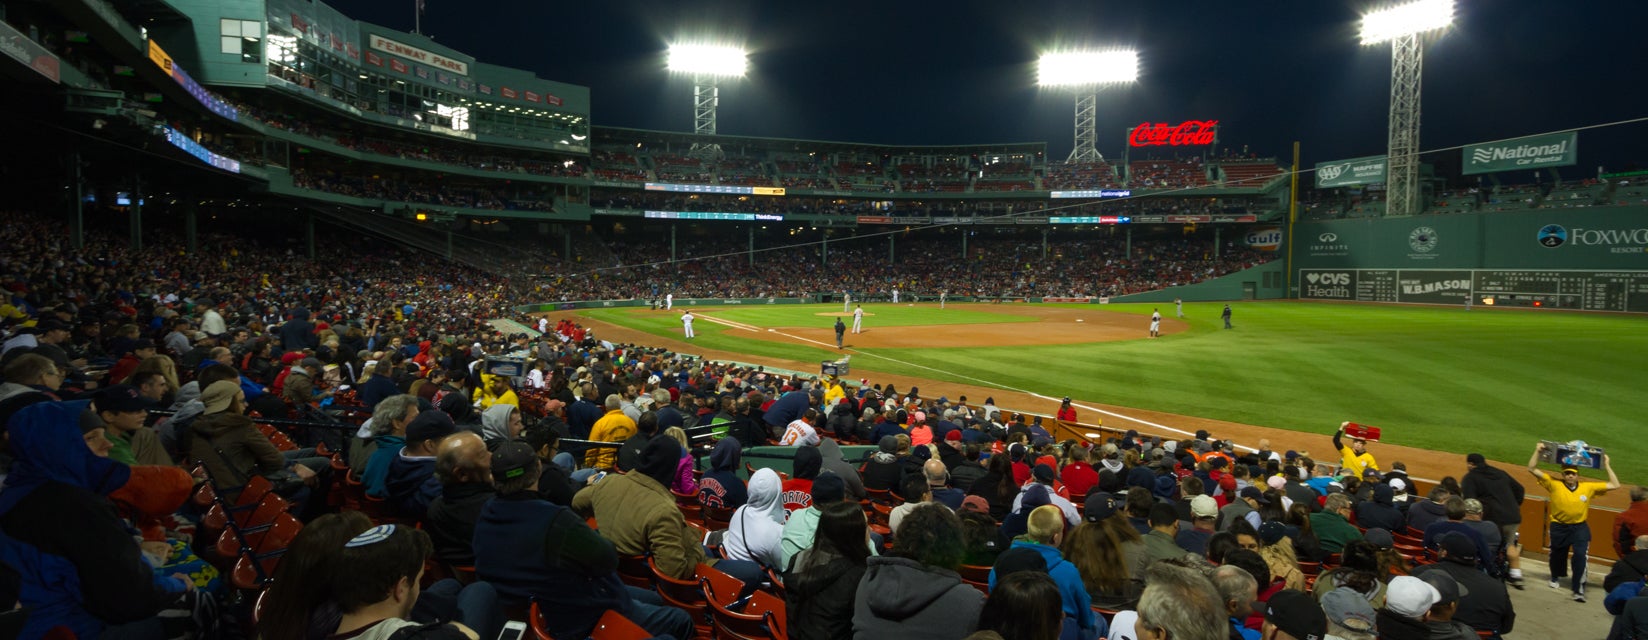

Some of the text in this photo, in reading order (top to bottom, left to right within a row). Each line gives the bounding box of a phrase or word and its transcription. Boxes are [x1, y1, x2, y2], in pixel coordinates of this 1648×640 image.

[377, 39, 462, 72] FENWAY PARK
[1129, 119, 1219, 147] Coca-Cola
[1492, 140, 1568, 161] National
[1516, 155, 1563, 166] Car Rental
[1247, 233, 1281, 244] Gulf
[1320, 272, 1351, 285] CVS
[1307, 284, 1350, 298] Health
[784, 429, 798, 446] 13
[782, 490, 812, 507] ORTIZ
